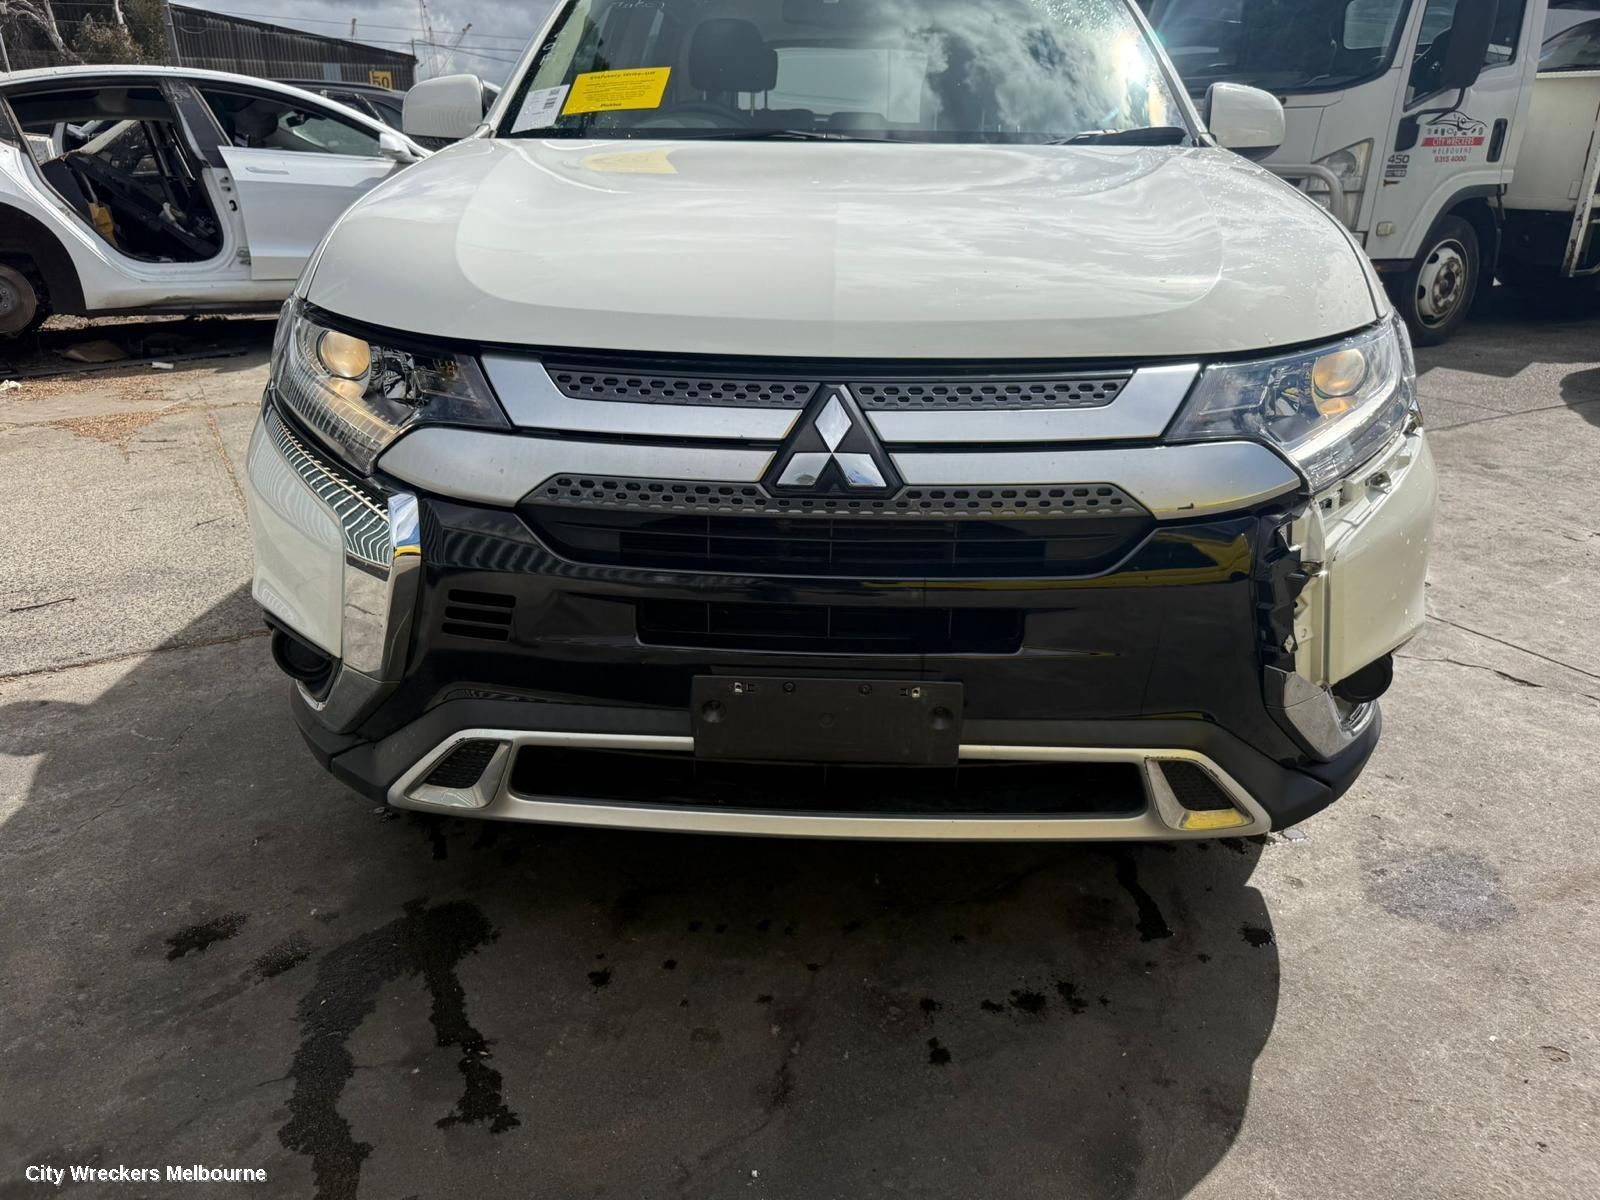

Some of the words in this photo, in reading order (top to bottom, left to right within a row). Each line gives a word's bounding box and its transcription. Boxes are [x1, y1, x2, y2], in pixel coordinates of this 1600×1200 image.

[1432, 138, 1445, 146] CITY
[1446, 137, 1473, 145] WRECKERS
[1432, 147, 1472, 155] MELBOURNE
[1387, 154, 1410, 164] 450
